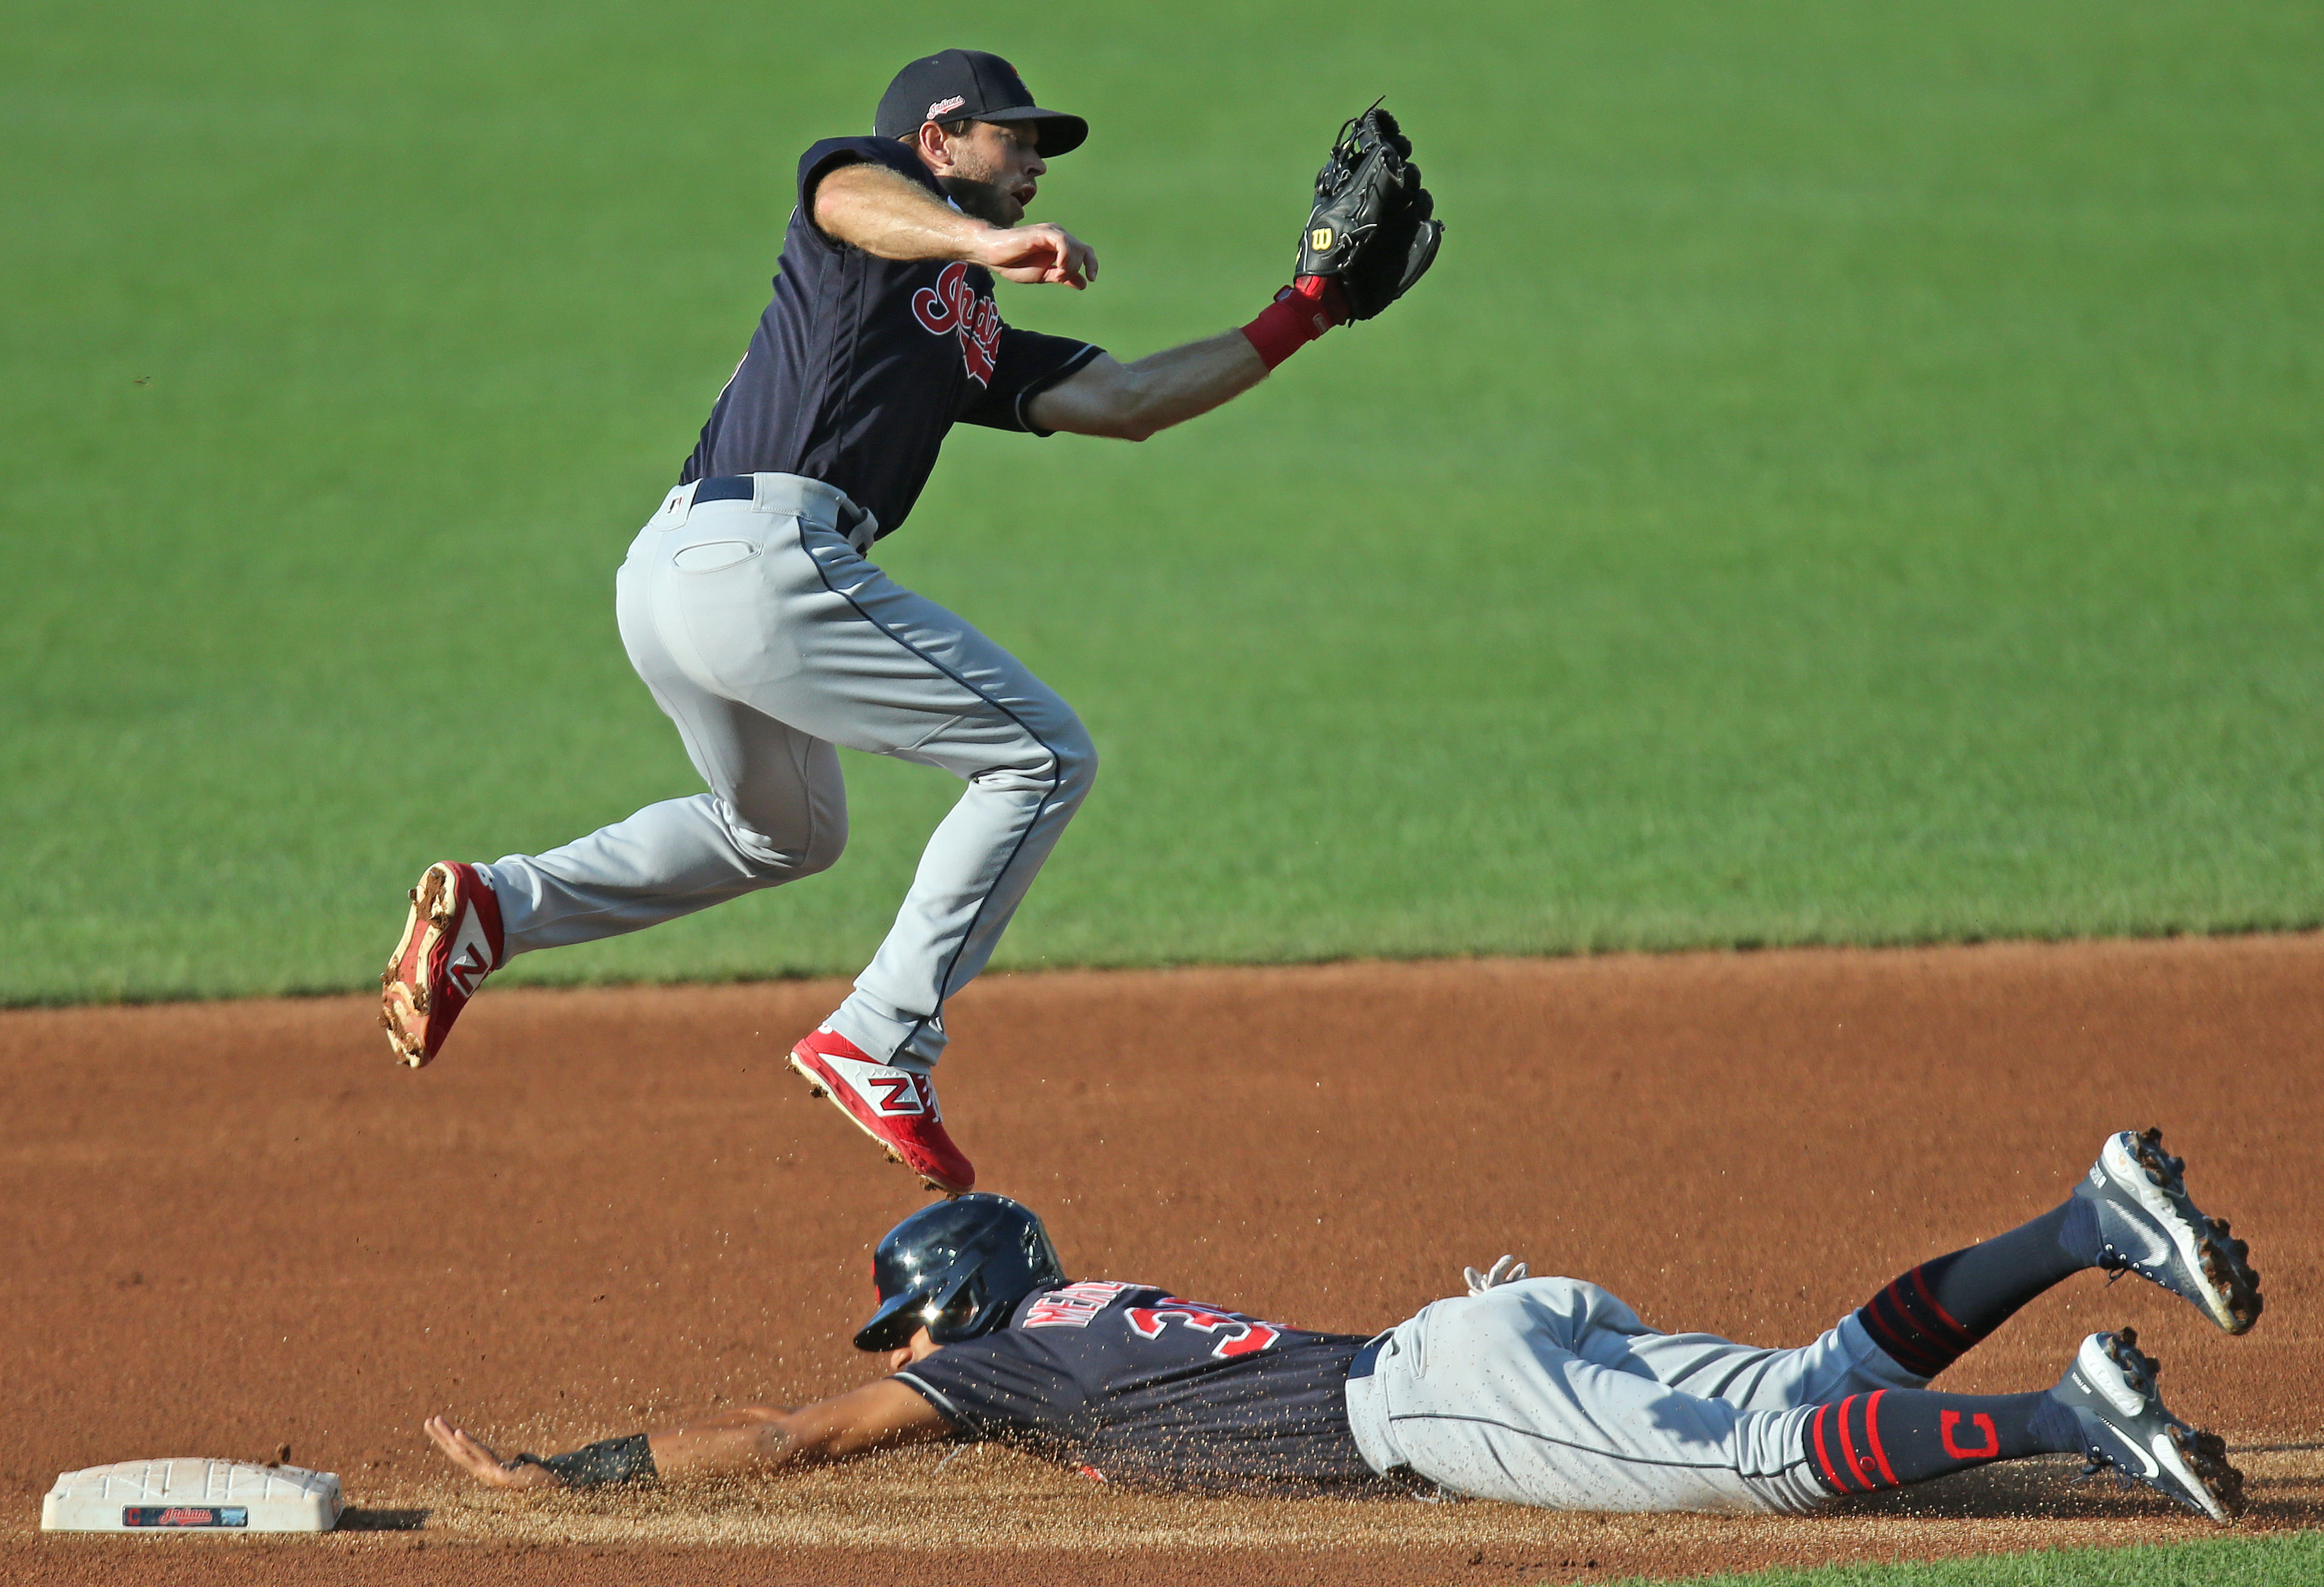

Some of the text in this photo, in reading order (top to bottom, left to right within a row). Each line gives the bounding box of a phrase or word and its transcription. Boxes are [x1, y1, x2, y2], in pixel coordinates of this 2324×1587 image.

[927, 95, 966, 119] Indians
[1124, 1297, 1302, 1359] 3
[1940, 1409, 1999, 1459] C
[128, 1508, 141, 1525] C
[159, 1507, 213, 1525] Indians
